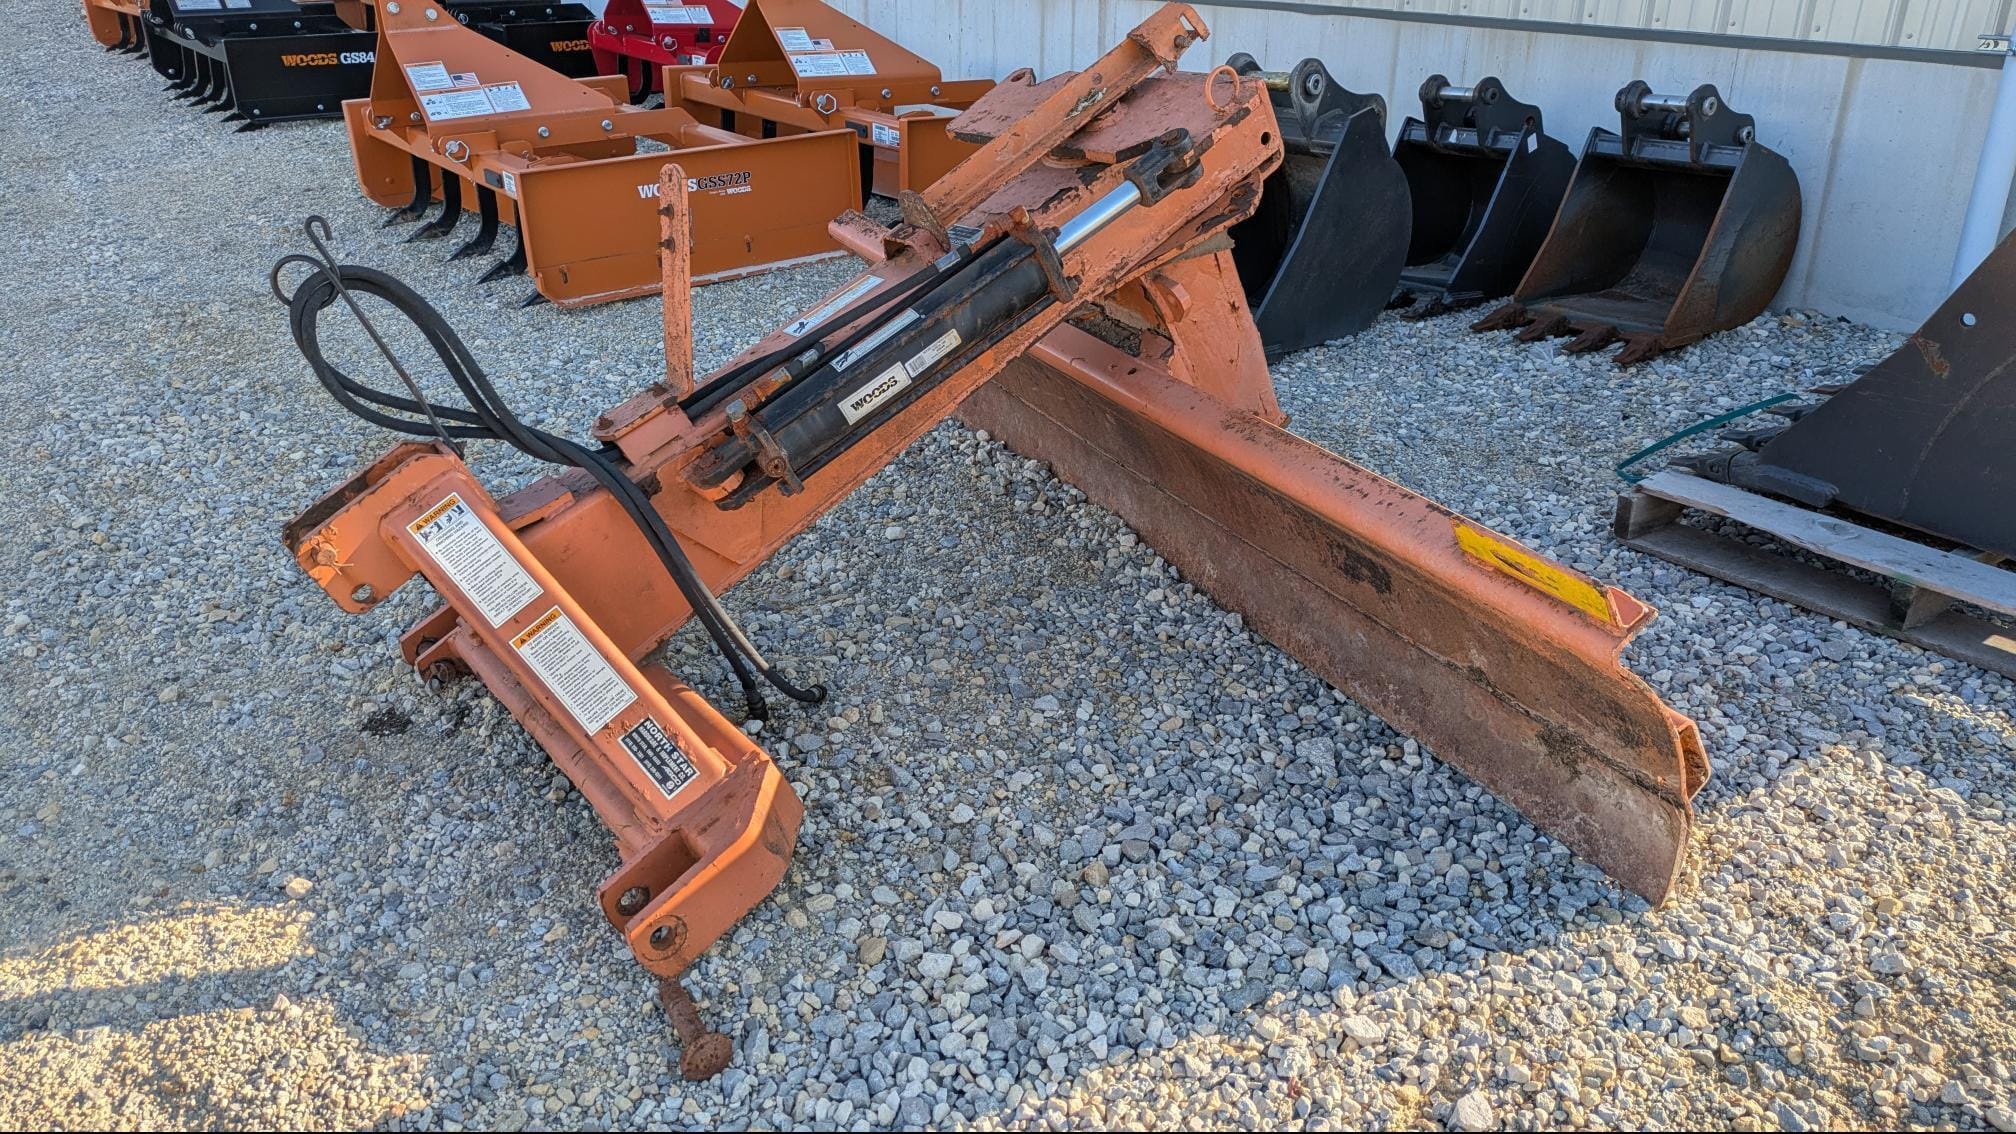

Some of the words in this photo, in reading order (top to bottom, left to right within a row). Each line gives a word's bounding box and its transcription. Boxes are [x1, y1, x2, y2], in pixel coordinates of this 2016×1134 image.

[281, 53, 338, 66] WOODS
[340, 51, 376, 65] GS84
[697, 171, 751, 190] GSS72P
[850, 376, 898, 411] WOODS
[422, 498, 456, 524] WARNING
[525, 612, 556, 638] WARNING
[642, 719, 673, 752] NORTH
[669, 750, 694, 776] STAR
[660, 763, 681, 786] AGCO
